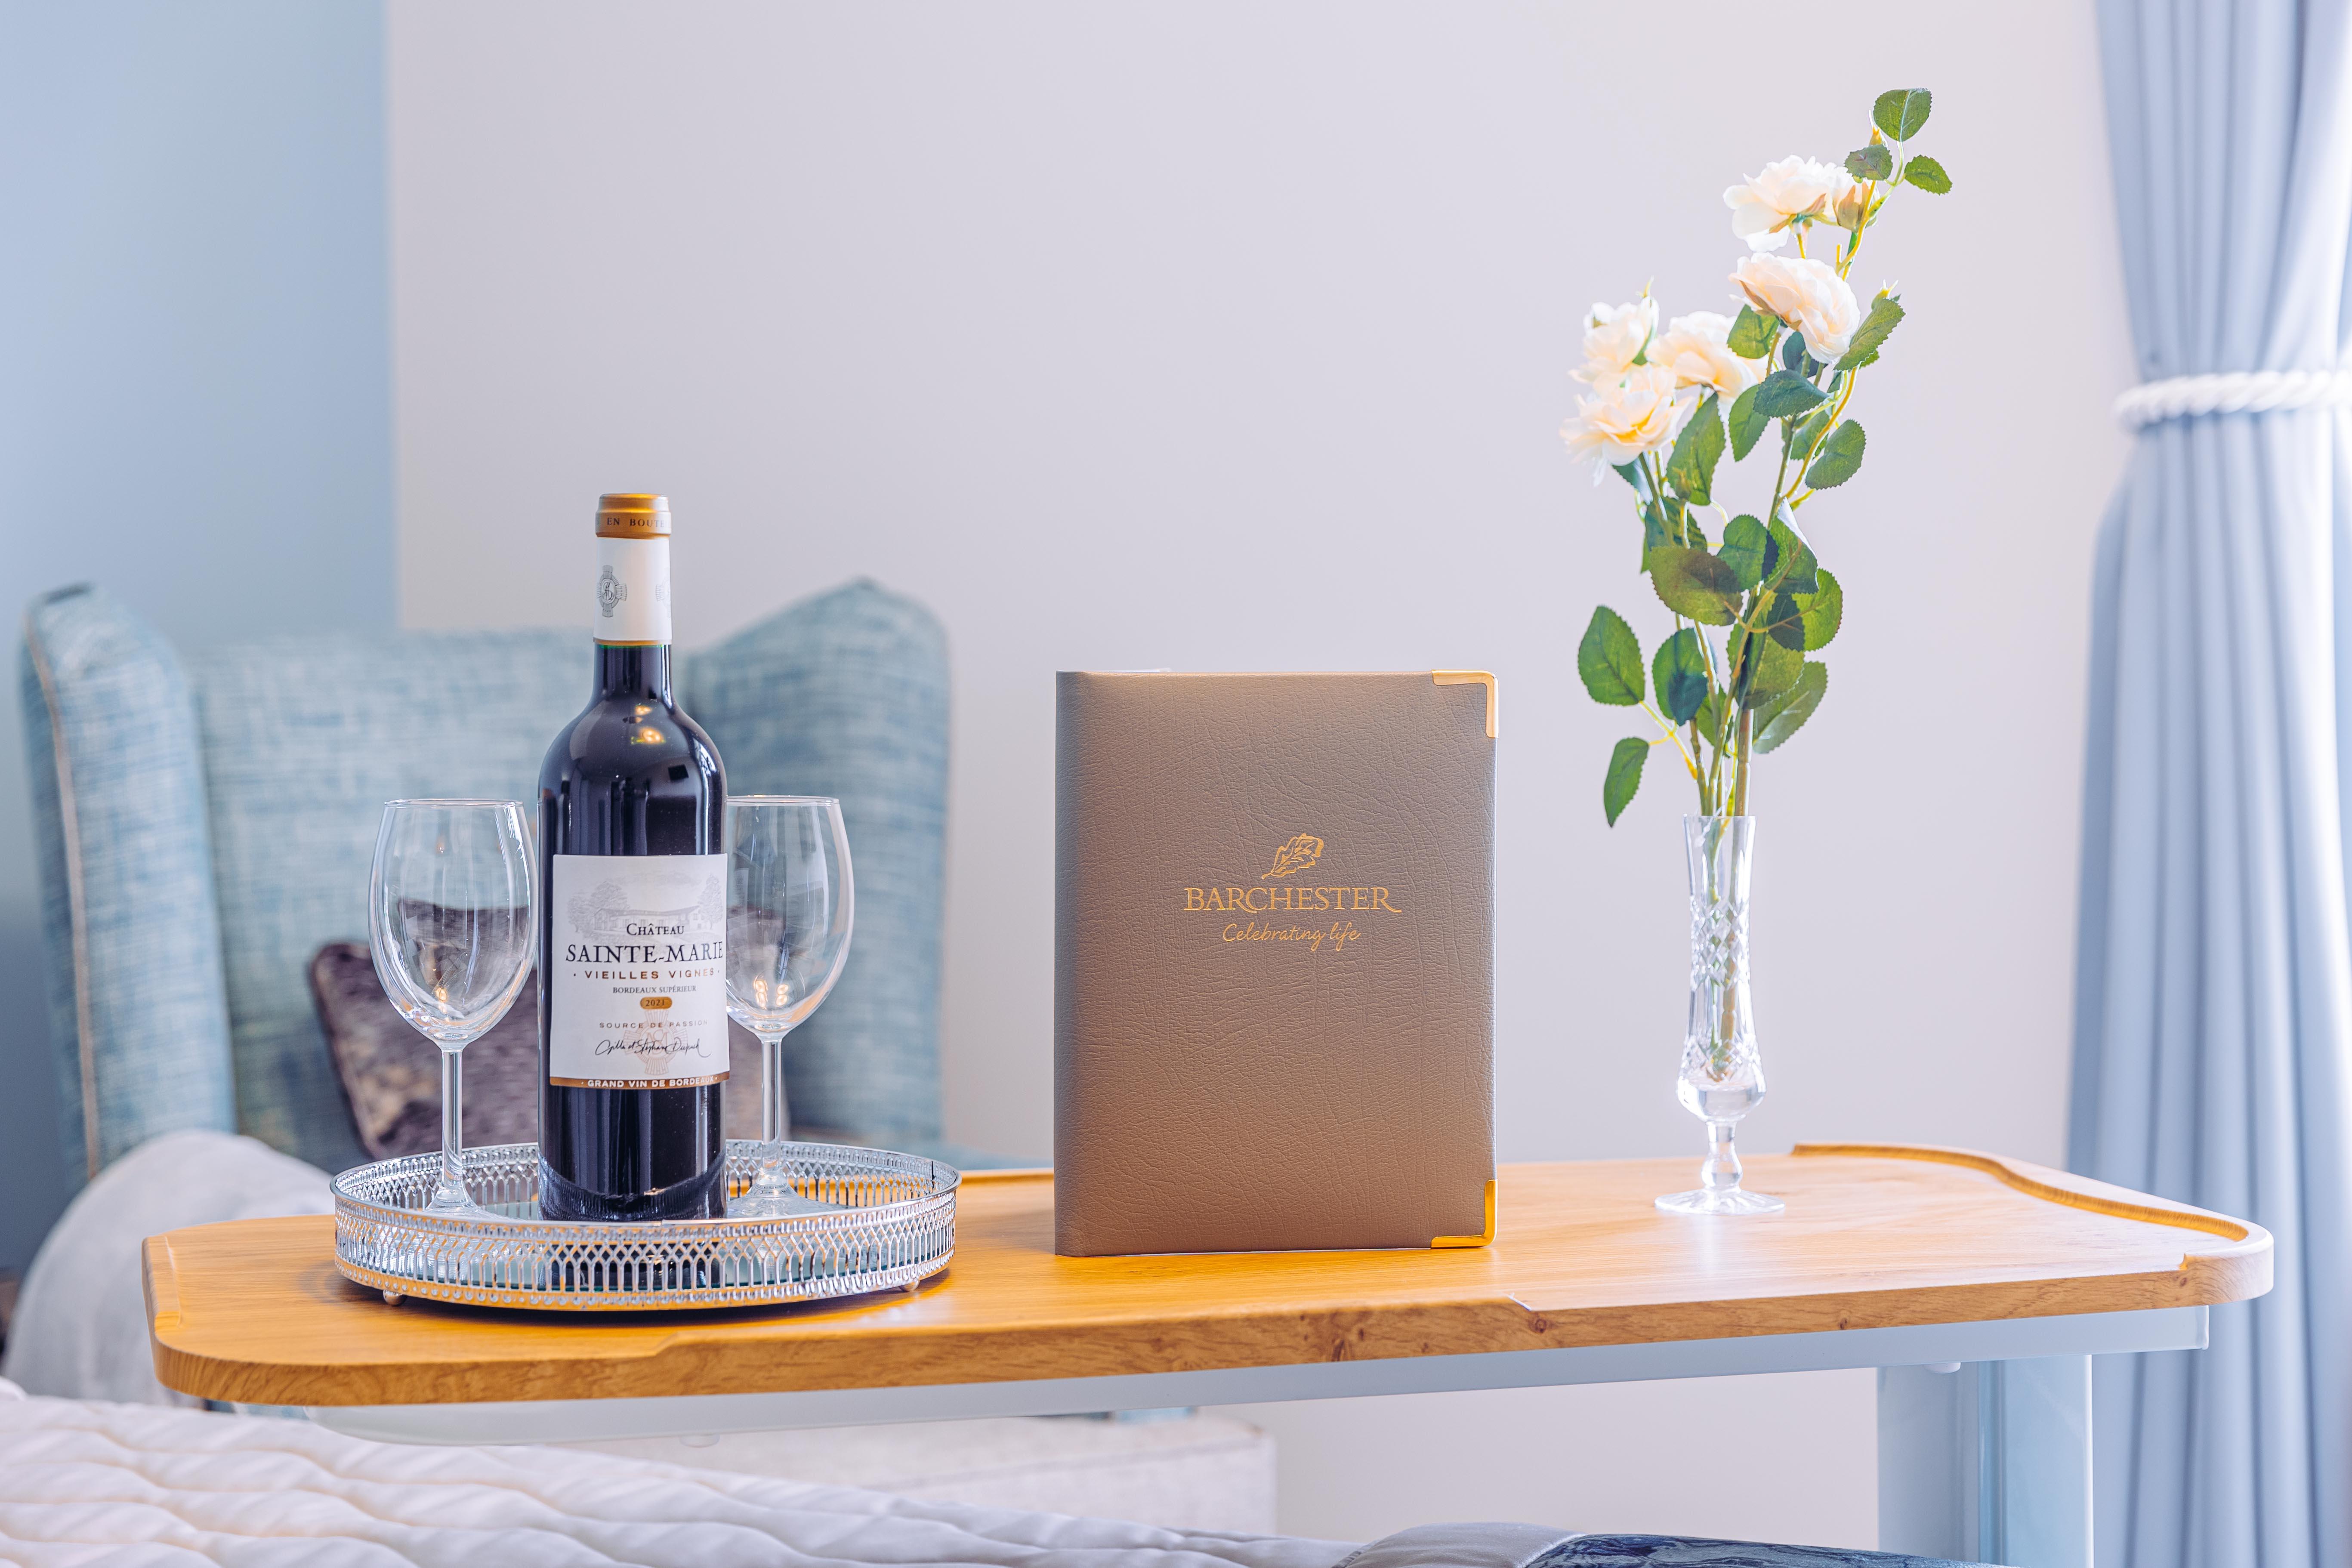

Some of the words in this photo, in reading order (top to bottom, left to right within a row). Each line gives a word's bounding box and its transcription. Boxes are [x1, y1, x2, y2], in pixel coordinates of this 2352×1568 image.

[1184, 887, 1402, 913] BARCHESTER
[1223, 922, 1326, 951] Celebrating
[1330, 922, 1361, 951] life
[565, 941, 723, 963] SAINTE-MARIE
[585, 971, 659, 979] VIEILLES
[669, 968, 714, 978] VIGNES
[669, 1019, 708, 1028] PASSION
[587, 1079, 624, 1088] GRAND
[628, 1080, 647, 1088] VIN
[651, 1079, 665, 1087] DE
[669, 1075, 714, 1087] BORDEAUX
